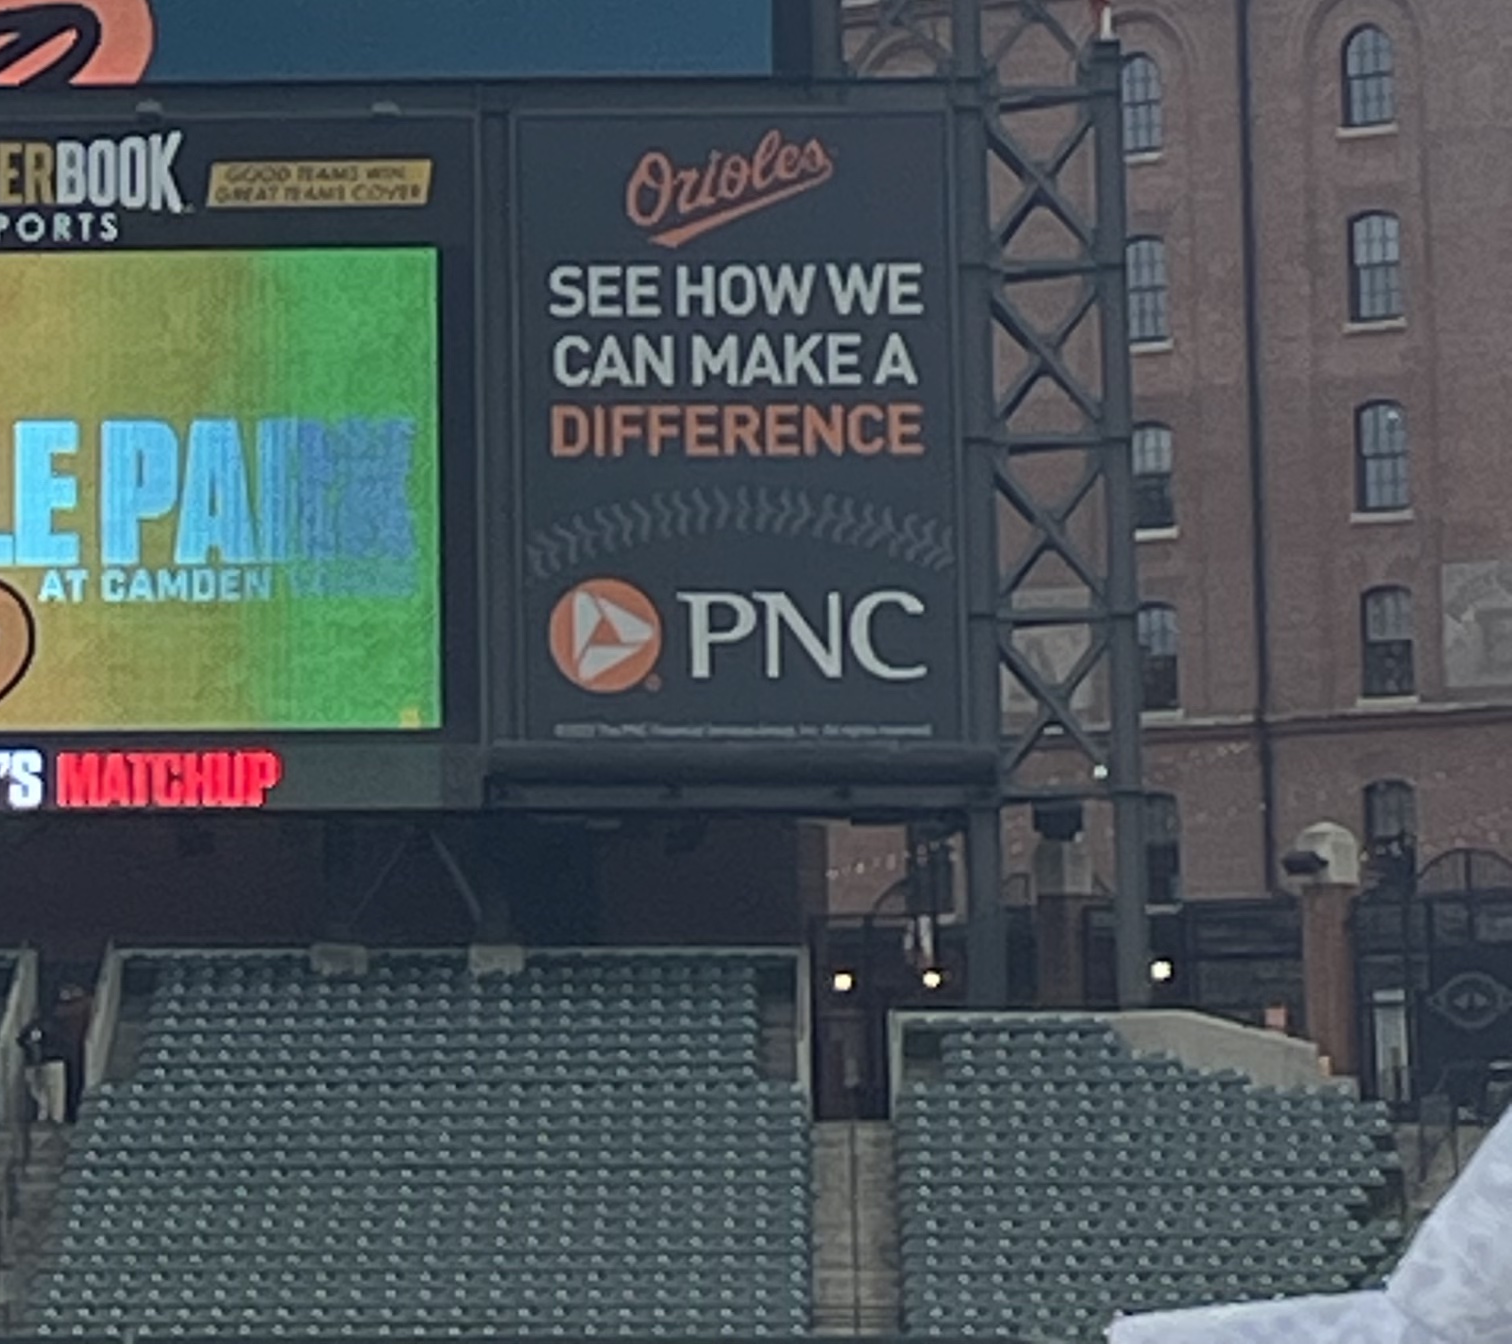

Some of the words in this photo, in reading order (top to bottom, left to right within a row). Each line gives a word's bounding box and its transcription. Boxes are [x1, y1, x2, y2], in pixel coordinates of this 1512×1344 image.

[627, 129, 834, 246] Orioles
[549, 264, 662, 318] SEE
[675, 263, 816, 317] HOW
[828, 262, 924, 316] WE
[553, 334, 674, 388] CAN
[691, 333, 862, 387] MAKE
[873, 332, 919, 386] A
[550, 403, 925, 458] DIFFERENCE
[38, 569, 88, 602] AT
[100, 568, 272, 602] CAMDEN
[676, 589, 928, 682] PNC
[55, 749, 282, 809] MATCHUP
